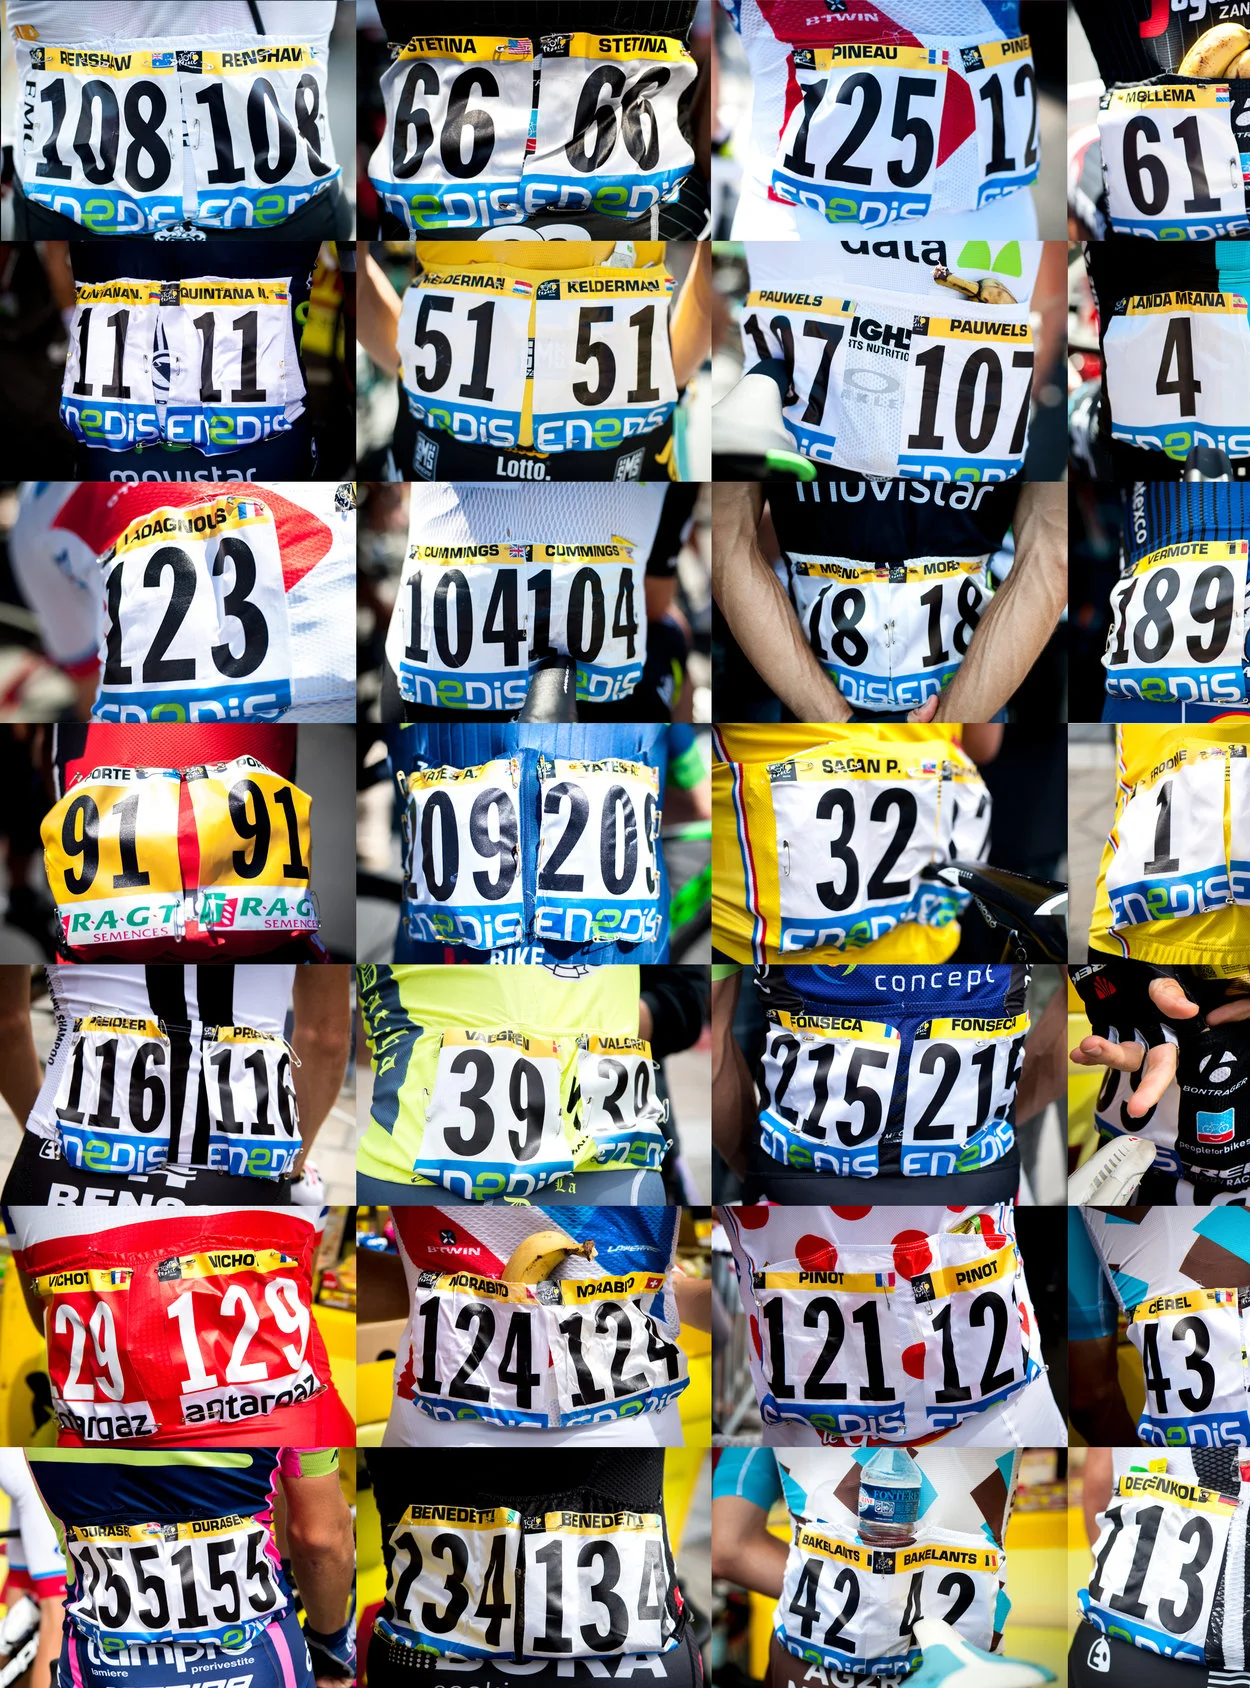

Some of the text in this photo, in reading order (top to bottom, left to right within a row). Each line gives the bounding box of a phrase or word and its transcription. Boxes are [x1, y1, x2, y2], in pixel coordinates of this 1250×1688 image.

[59, 50, 132, 72] RENSHAW
[407, 38, 477, 54] STETINA
[599, 38, 667, 53] STETINA
[833, 45, 898, 59] PINEAU
[36, 78, 172, 192] 108
[196, 73, 332, 184] 108
[392, 62, 499, 179] 66
[565, 64, 671, 173] 66
[783, 72, 936, 188] 125
[1126, 89, 1195, 103] MOLLEMA
[1123, 116, 1221, 216] 61
[568, 280, 660, 293] KELDERMAN
[759, 290, 823, 307] PAUWELS
[950, 319, 1028, 337] PAUWELS
[1133, 291, 1225, 309] LANDA MEANA
[73, 307, 131, 399] 11
[193, 311, 266, 402] 11
[415, 295, 495, 402] 51
[572, 305, 660, 406] 51
[1156, 317, 1202, 417] 4
[908, 345, 1034, 455] 107
[124, 508, 226, 545] LADAGNOUS
[425, 544, 499, 558] CUMMINGS
[546, 545, 620, 557] CUMMINGS
[1147, 544, 1208, 565] VERMOTE
[103, 537, 269, 685] 123
[405, 568, 527, 668] 104
[528, 567, 638, 663] 104
[809, 584, 869, 667] 18
[920, 576, 991, 667] 18
[1110, 565, 1235, 665] 189
[822, 759, 901, 774] SAGAN P.
[1150, 750, 1187, 781] FROOME
[61, 795, 150, 895] 91
[228, 779, 309, 880] 91
[816, 788, 918, 912] 32
[1144, 780, 1180, 875] 1
[93, 927, 168, 942] SEMENCES
[876, 968, 995, 992] concept
[952, 1017, 1017, 1032] FONSECA
[465, 1030, 530, 1051] VALGREN
[599, 1037, 647, 1052] VALGREN
[791, 1017, 863, 1033] FONSECA
[55, 1036, 167, 1134] 116
[210, 1049, 300, 1137] 116
[443, 1049, 546, 1161] 39
[771, 1033, 890, 1147] 215
[1183, 1077, 1248, 1097] BONTRAGER
[49, 1271, 90, 1287] VICHOT
[577, 1277, 635, 1298] MORABITO
[799, 1272, 845, 1284] PINOT
[956, 1260, 998, 1286] PINOT
[167, 1277, 310, 1394] 129
[417, 1296, 540, 1409] 124
[559, 1299, 679, 1407] 124
[764, 1296, 896, 1401] 121
[1143, 1316, 1215, 1414] 43
[411, 1505, 495, 1525] BENEDETTI
[801, 1534, 860, 1562] BAKELANTS
[904, 1549, 977, 1567] BAKELANTS
[170, 1530, 277, 1629] 155
[533, 1539, 677, 1654] 134
[789, 1558, 861, 1654] 42
[1089, 1504, 1214, 1634] 113
[91, 1668, 129, 1678] lamiere
[191, 1655, 255, 1674] prerivestite
